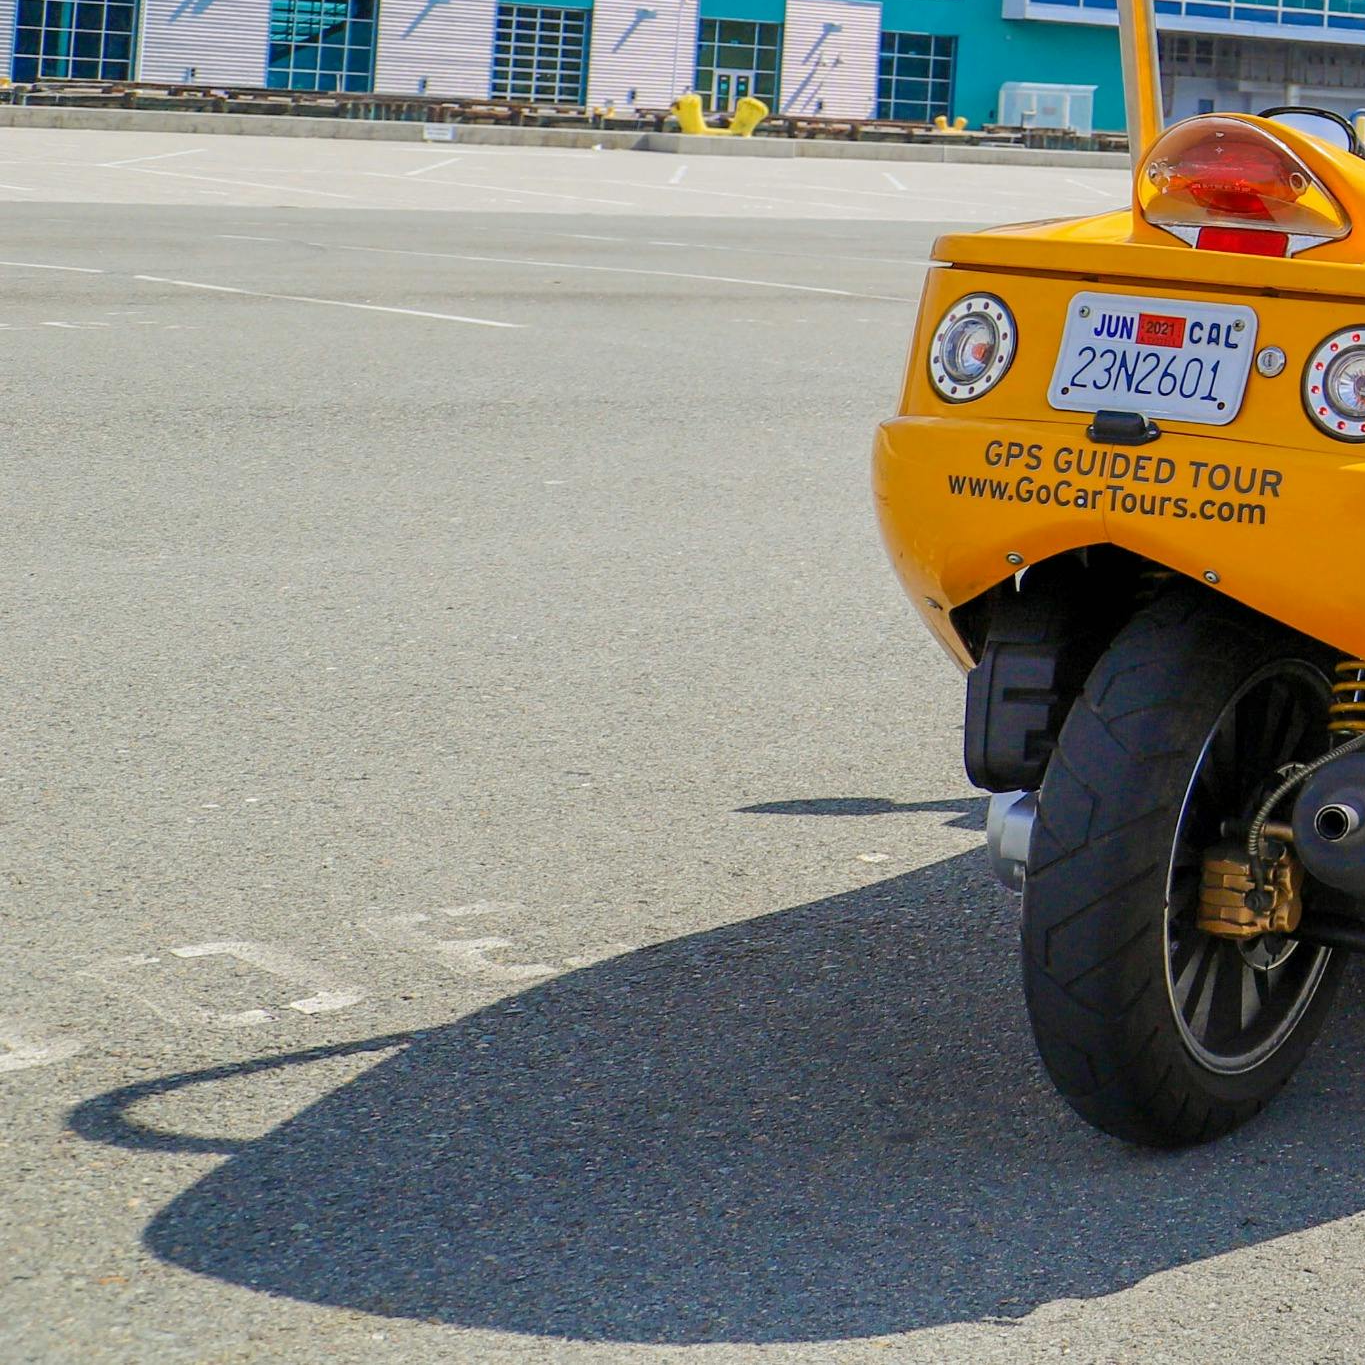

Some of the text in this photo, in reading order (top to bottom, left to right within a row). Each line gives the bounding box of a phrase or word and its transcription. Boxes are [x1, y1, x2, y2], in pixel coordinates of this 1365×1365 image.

[1093, 313, 1238, 349] JUN 2021 CAL
[1070, 346, 1220, 402] 23N2601
[984, 439, 1283, 498] GPS GUIDED TOUR
[948, 474, 1266, 525] www.GoCarTours.com
